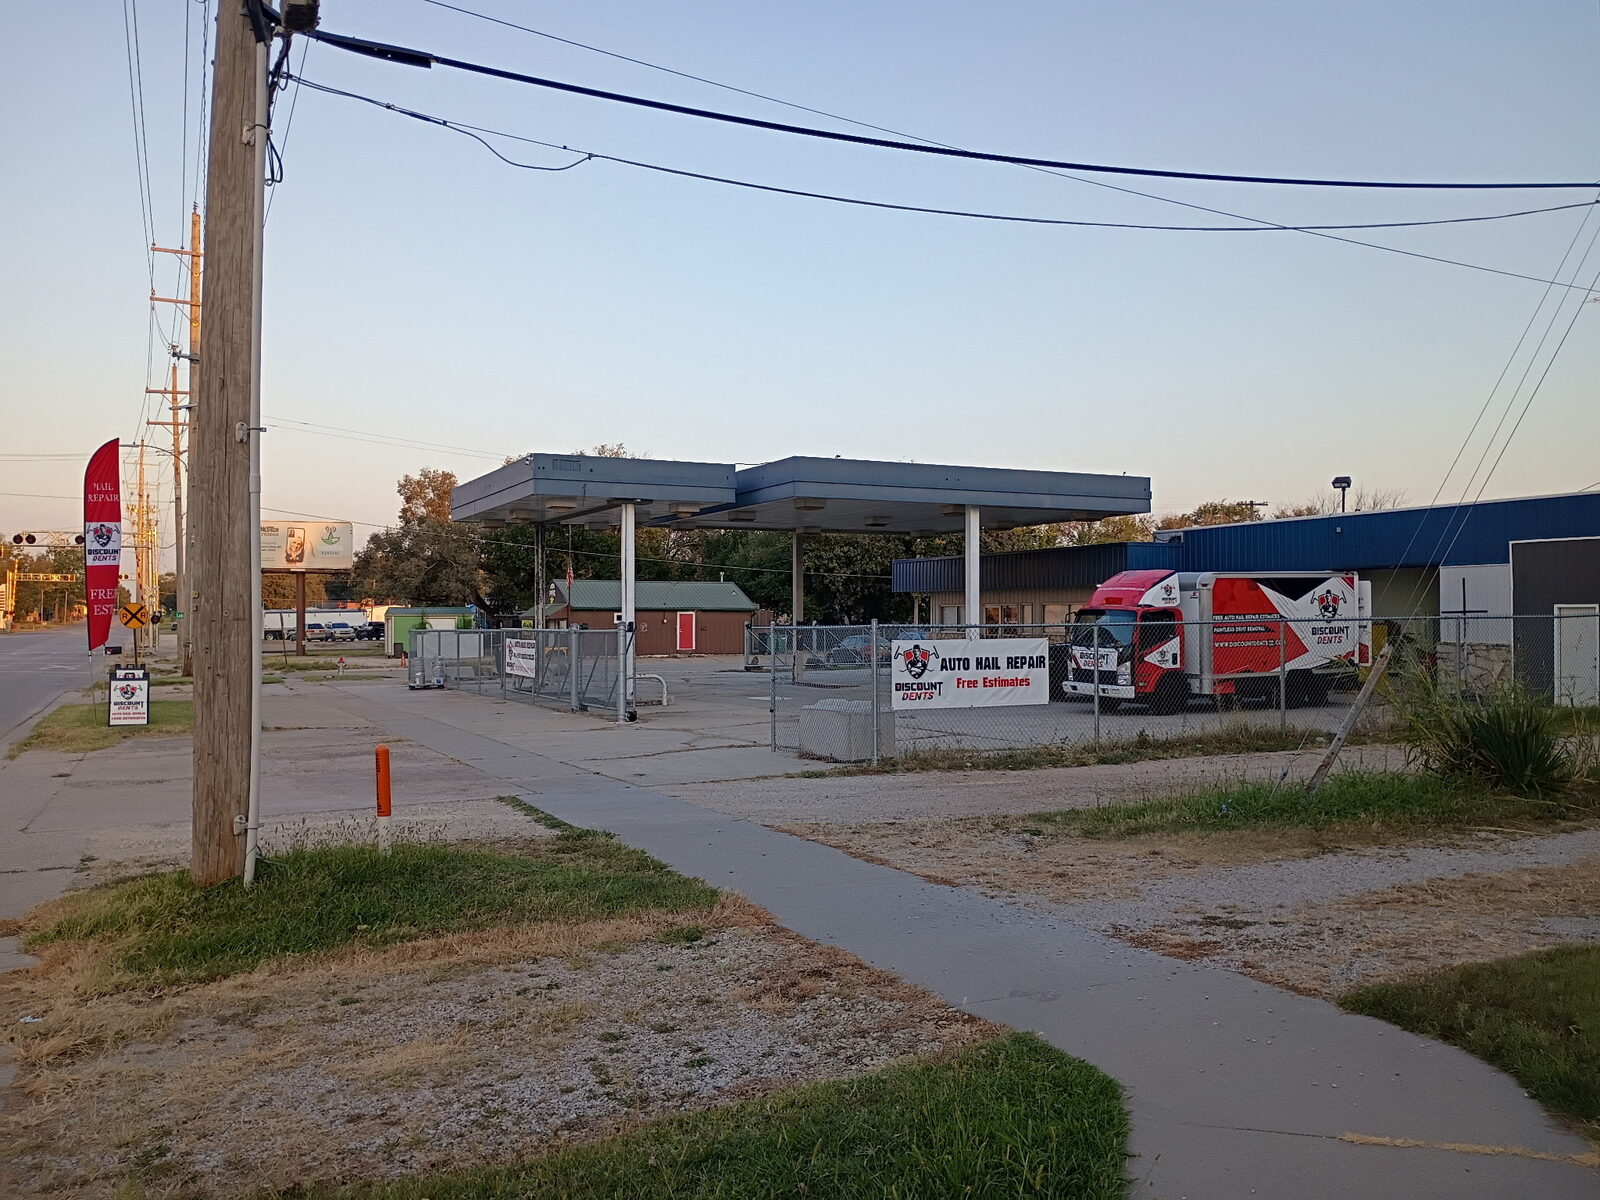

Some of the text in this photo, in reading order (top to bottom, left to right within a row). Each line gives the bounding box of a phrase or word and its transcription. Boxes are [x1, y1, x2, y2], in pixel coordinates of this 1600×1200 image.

[88, 493, 120, 502] REPAIR
[121, 612, 128, 620] R
[1311, 626, 1350, 640] DISCOUNT
[1317, 636, 1343, 645] DENTS
[940, 655, 1046, 672] AUTO HAIL REPAIR
[956, 676, 1031, 689] Free Estimates
[895, 681, 943, 696] DISCOUNT
[902, 691, 935, 701] DENTS
